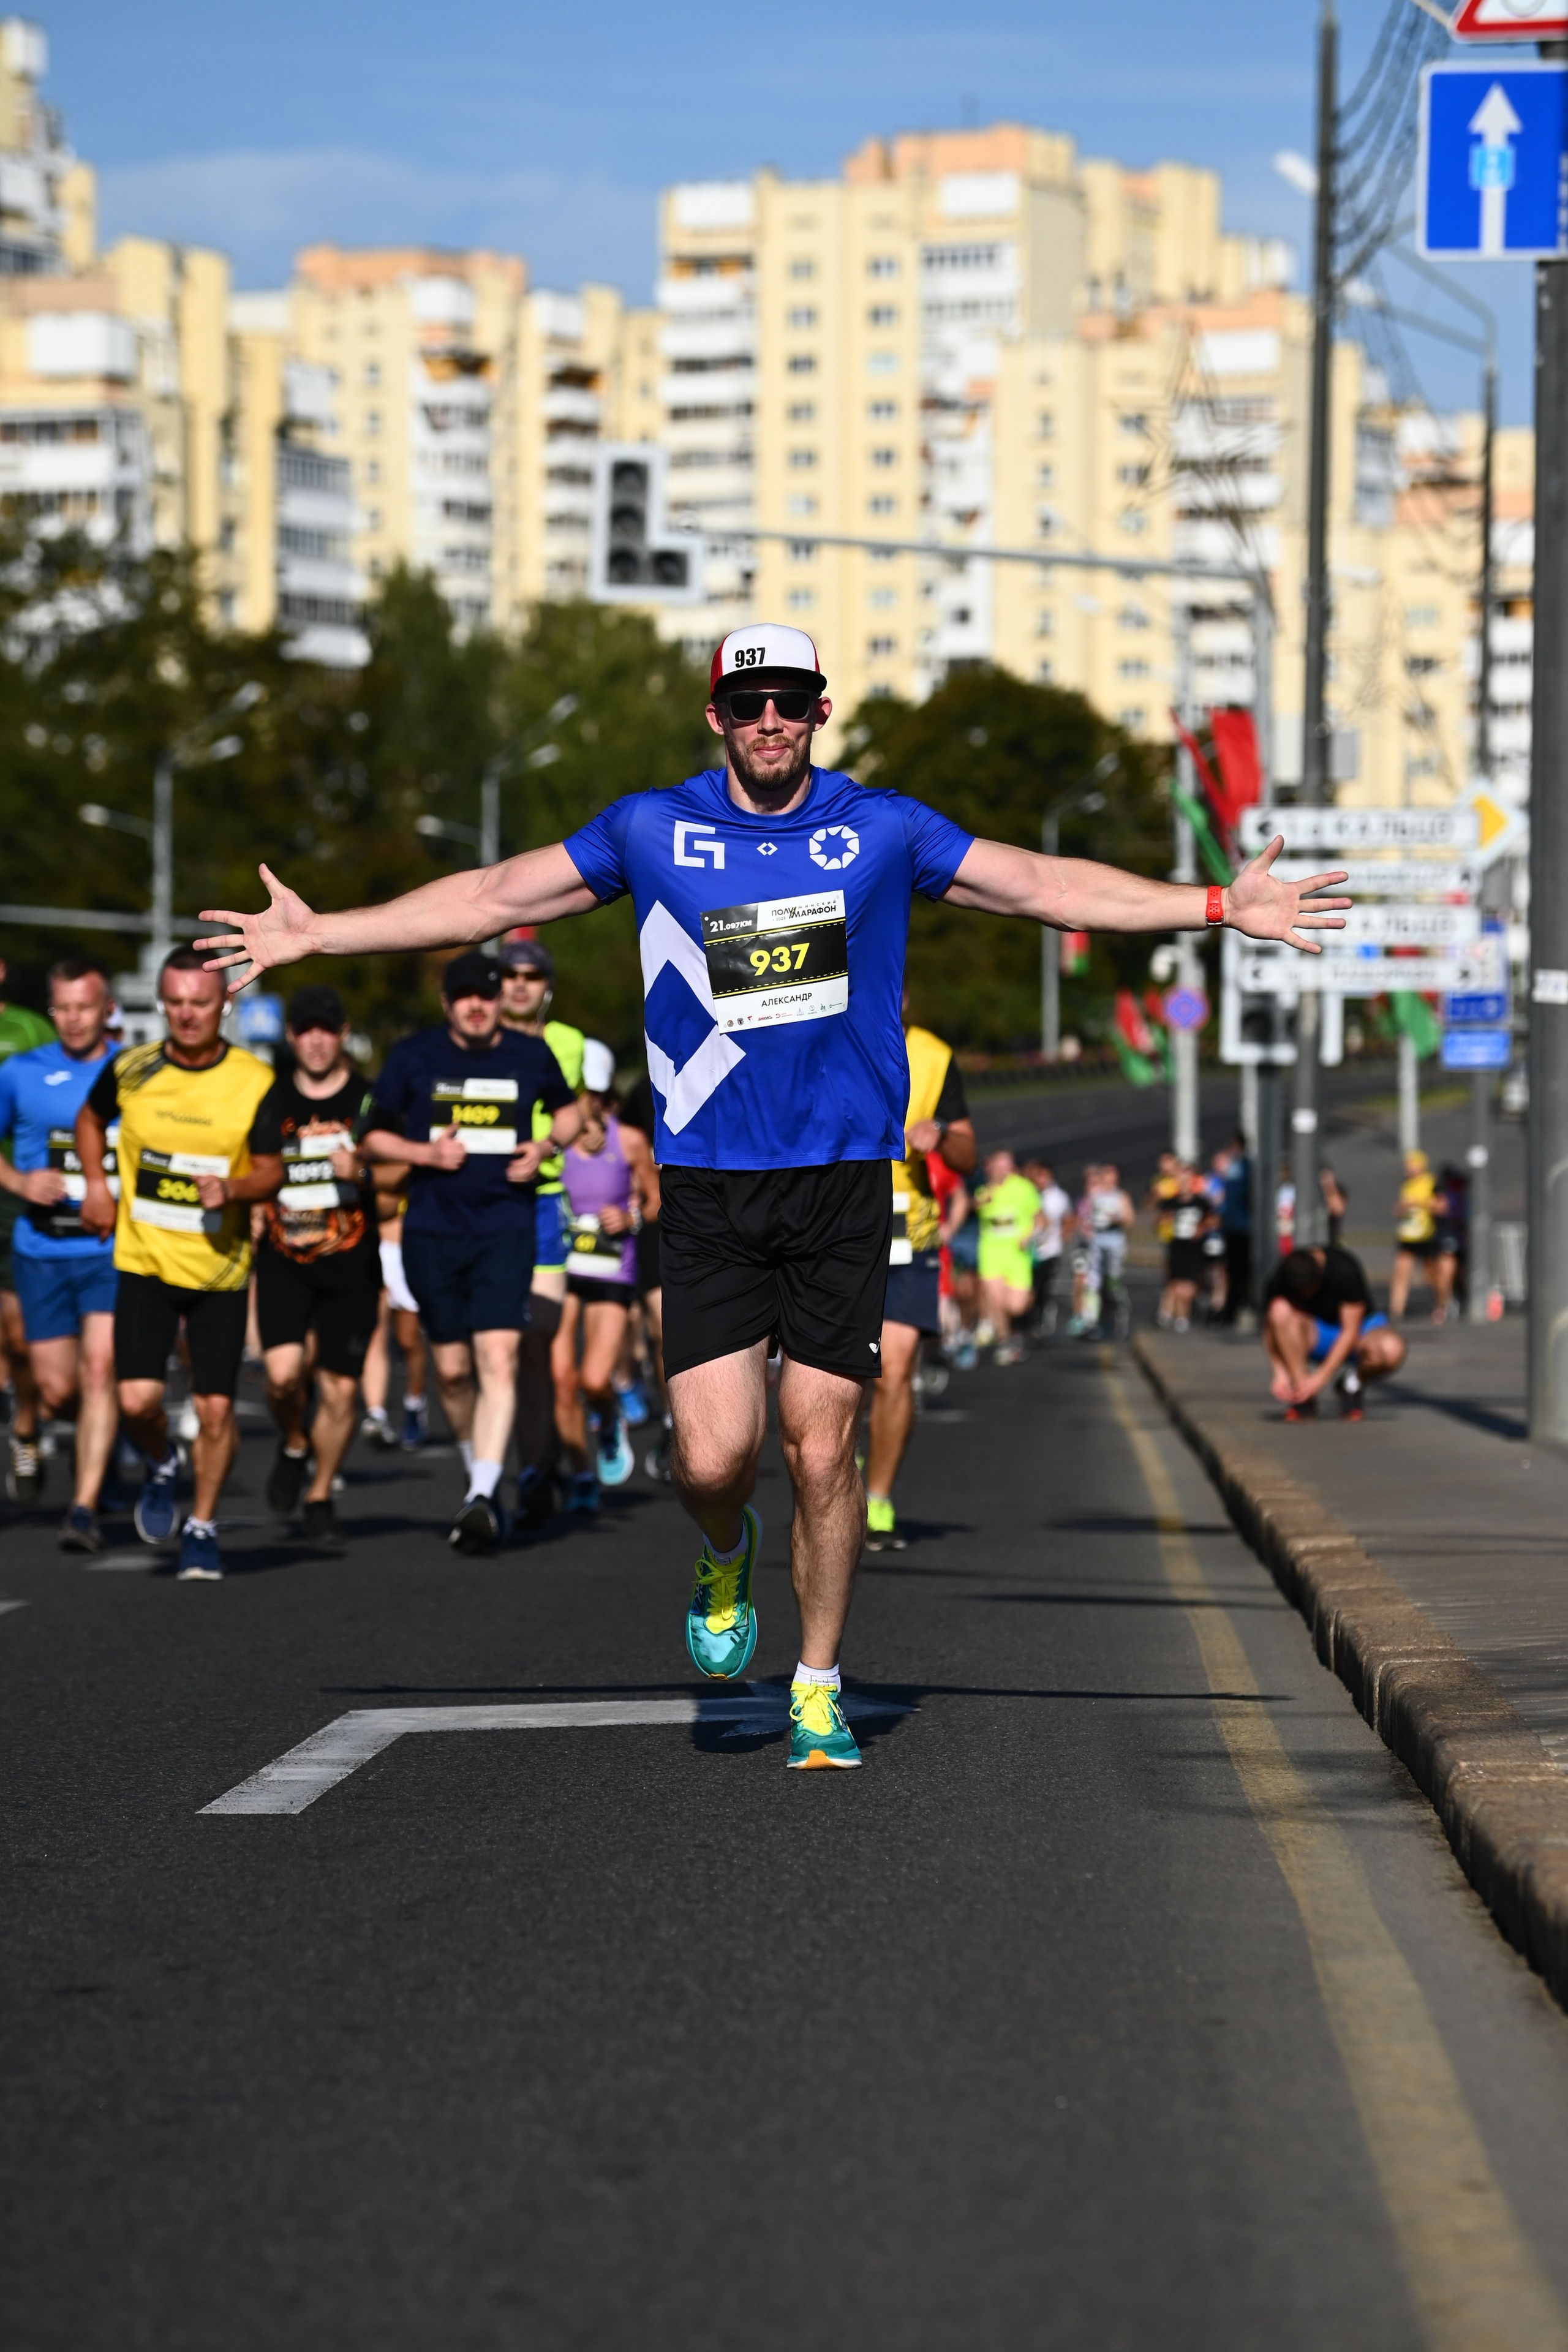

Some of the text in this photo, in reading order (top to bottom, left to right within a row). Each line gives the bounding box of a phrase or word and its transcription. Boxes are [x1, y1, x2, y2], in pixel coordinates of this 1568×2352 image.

[735, 647, 766, 668] 937
[750, 943, 810, 976] 937
[761, 993, 812, 1007] АЛЕКСАНДР
[451, 1104, 500, 1125] 1409
